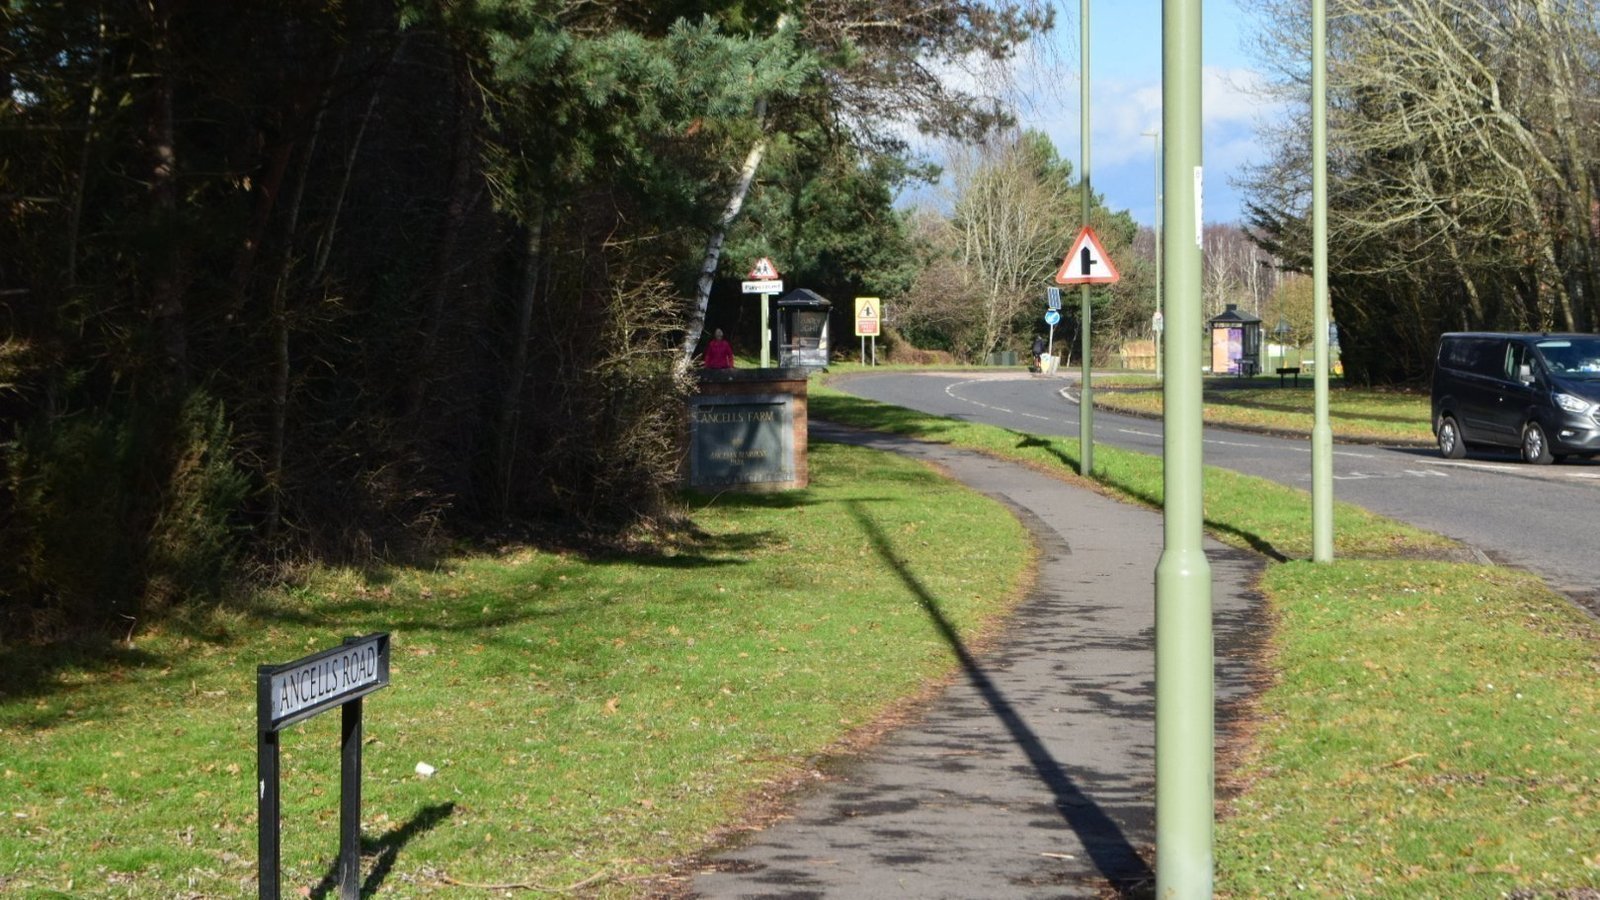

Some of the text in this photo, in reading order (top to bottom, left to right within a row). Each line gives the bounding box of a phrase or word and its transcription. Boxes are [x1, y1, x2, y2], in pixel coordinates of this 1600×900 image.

[702, 411, 774, 424] ANCELLS FARM
[280, 646, 376, 711] ANCELLS ROAD
